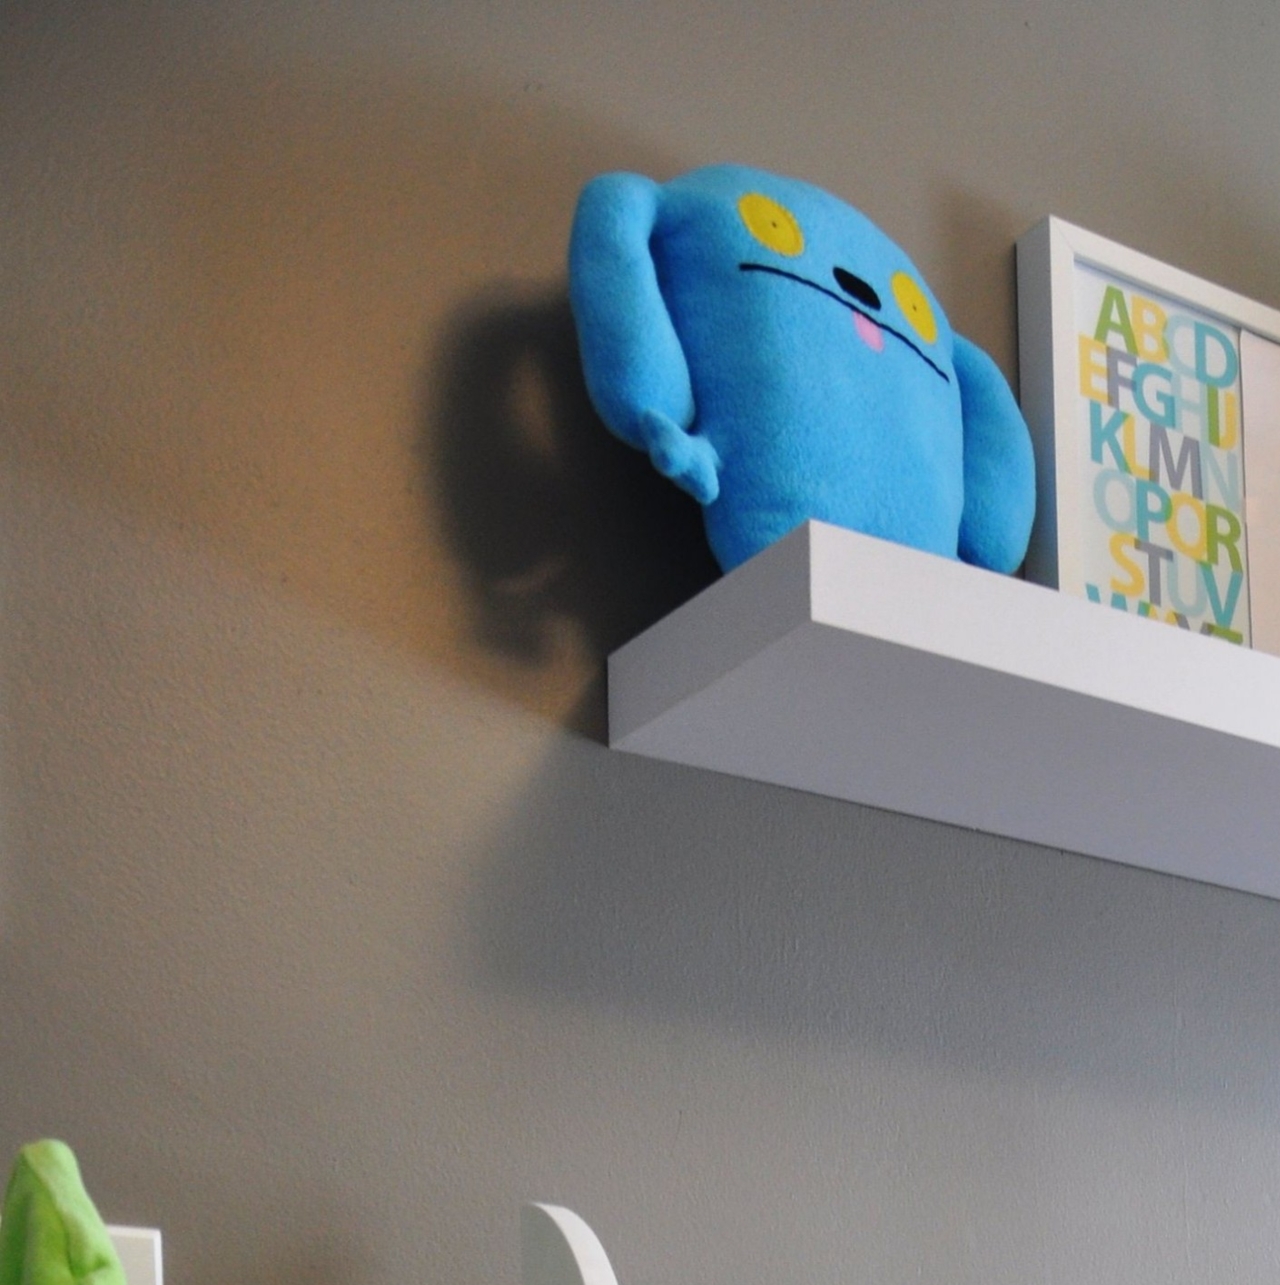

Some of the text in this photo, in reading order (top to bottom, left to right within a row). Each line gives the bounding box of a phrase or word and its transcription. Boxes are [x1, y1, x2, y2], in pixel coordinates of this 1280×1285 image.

[1093, 285, 1238, 389] ABCD
[1089, 399, 1240, 515] KLMN
[1092, 470, 1242, 574] OPQR
[1108, 532, 1244, 630] STUV
